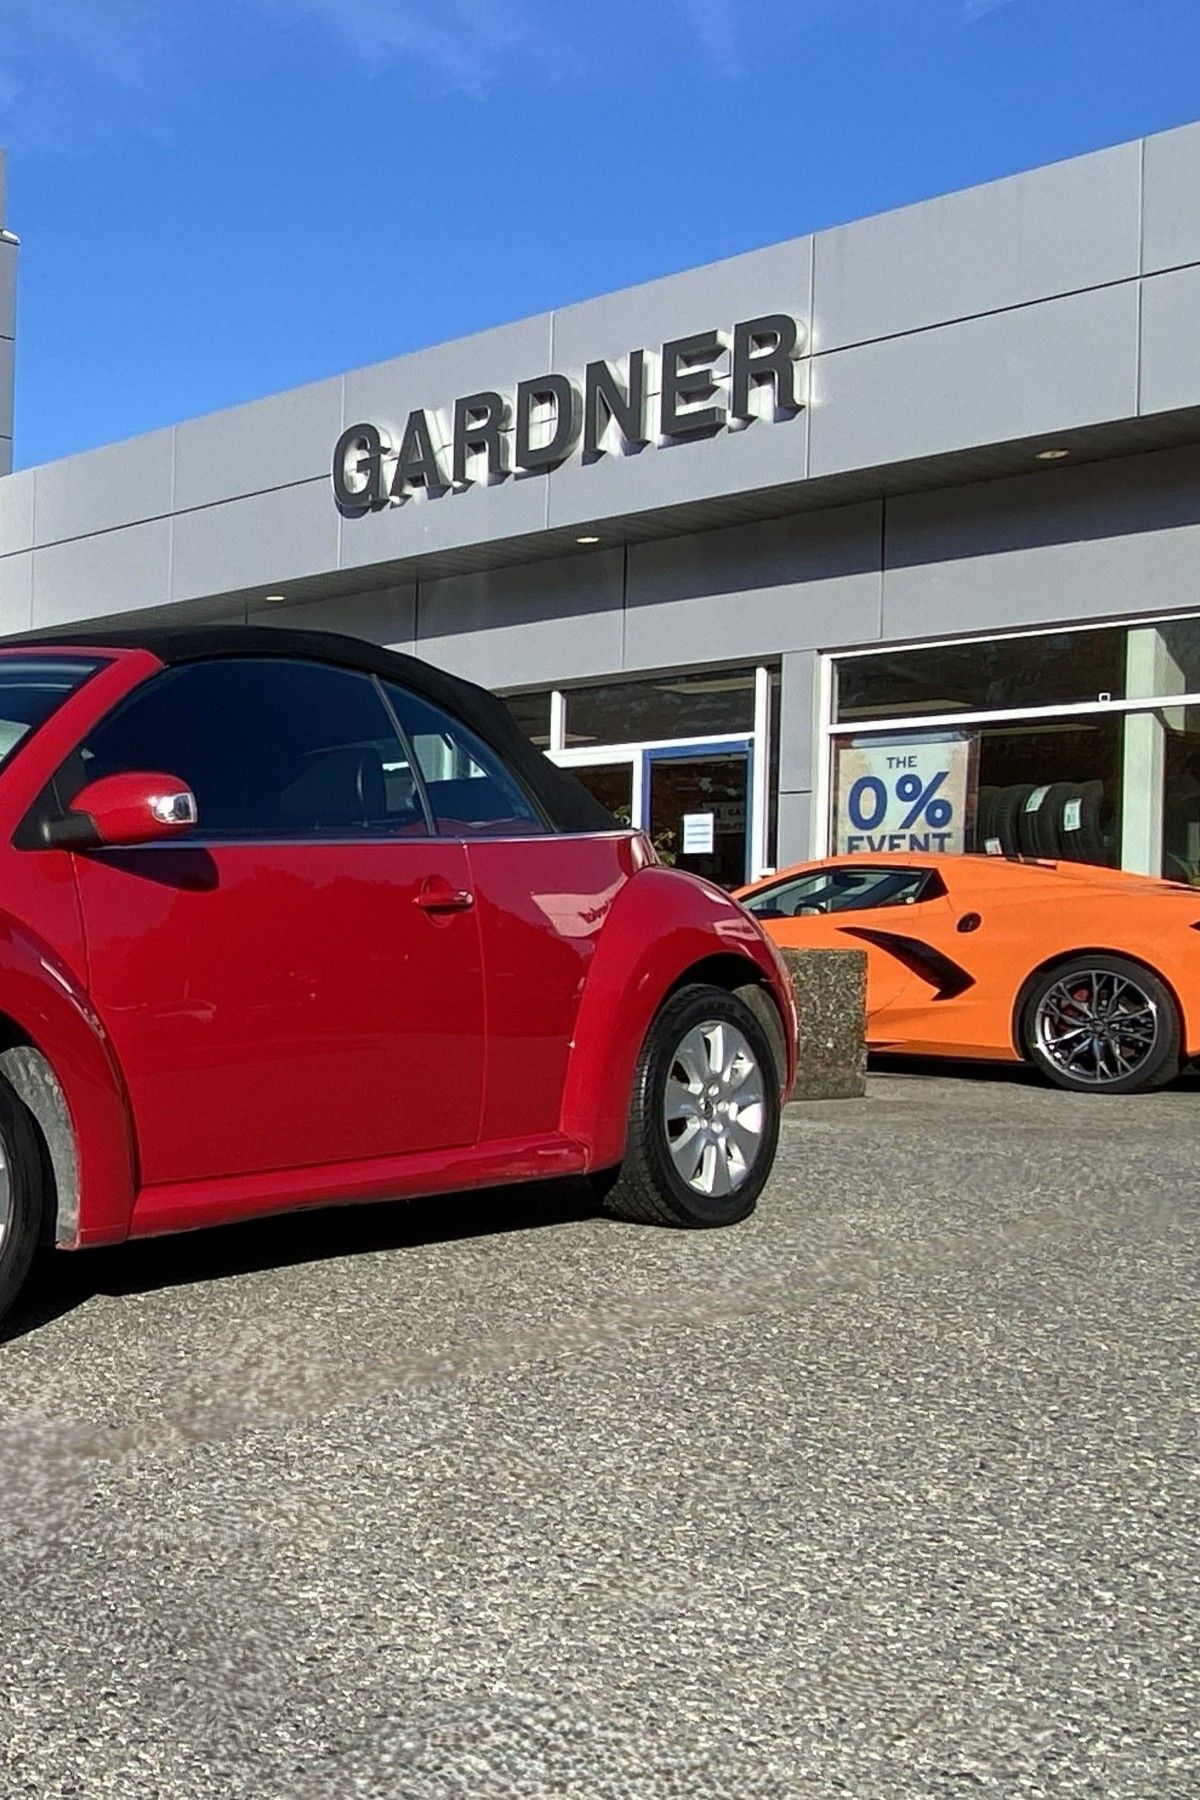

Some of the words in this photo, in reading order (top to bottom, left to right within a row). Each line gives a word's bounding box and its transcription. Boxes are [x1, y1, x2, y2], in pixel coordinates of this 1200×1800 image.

[332, 313, 802, 515] GARDNER
[886, 755, 918, 769] THE
[848, 771, 953, 831] 0%
[847, 832, 952, 854] EVENT
